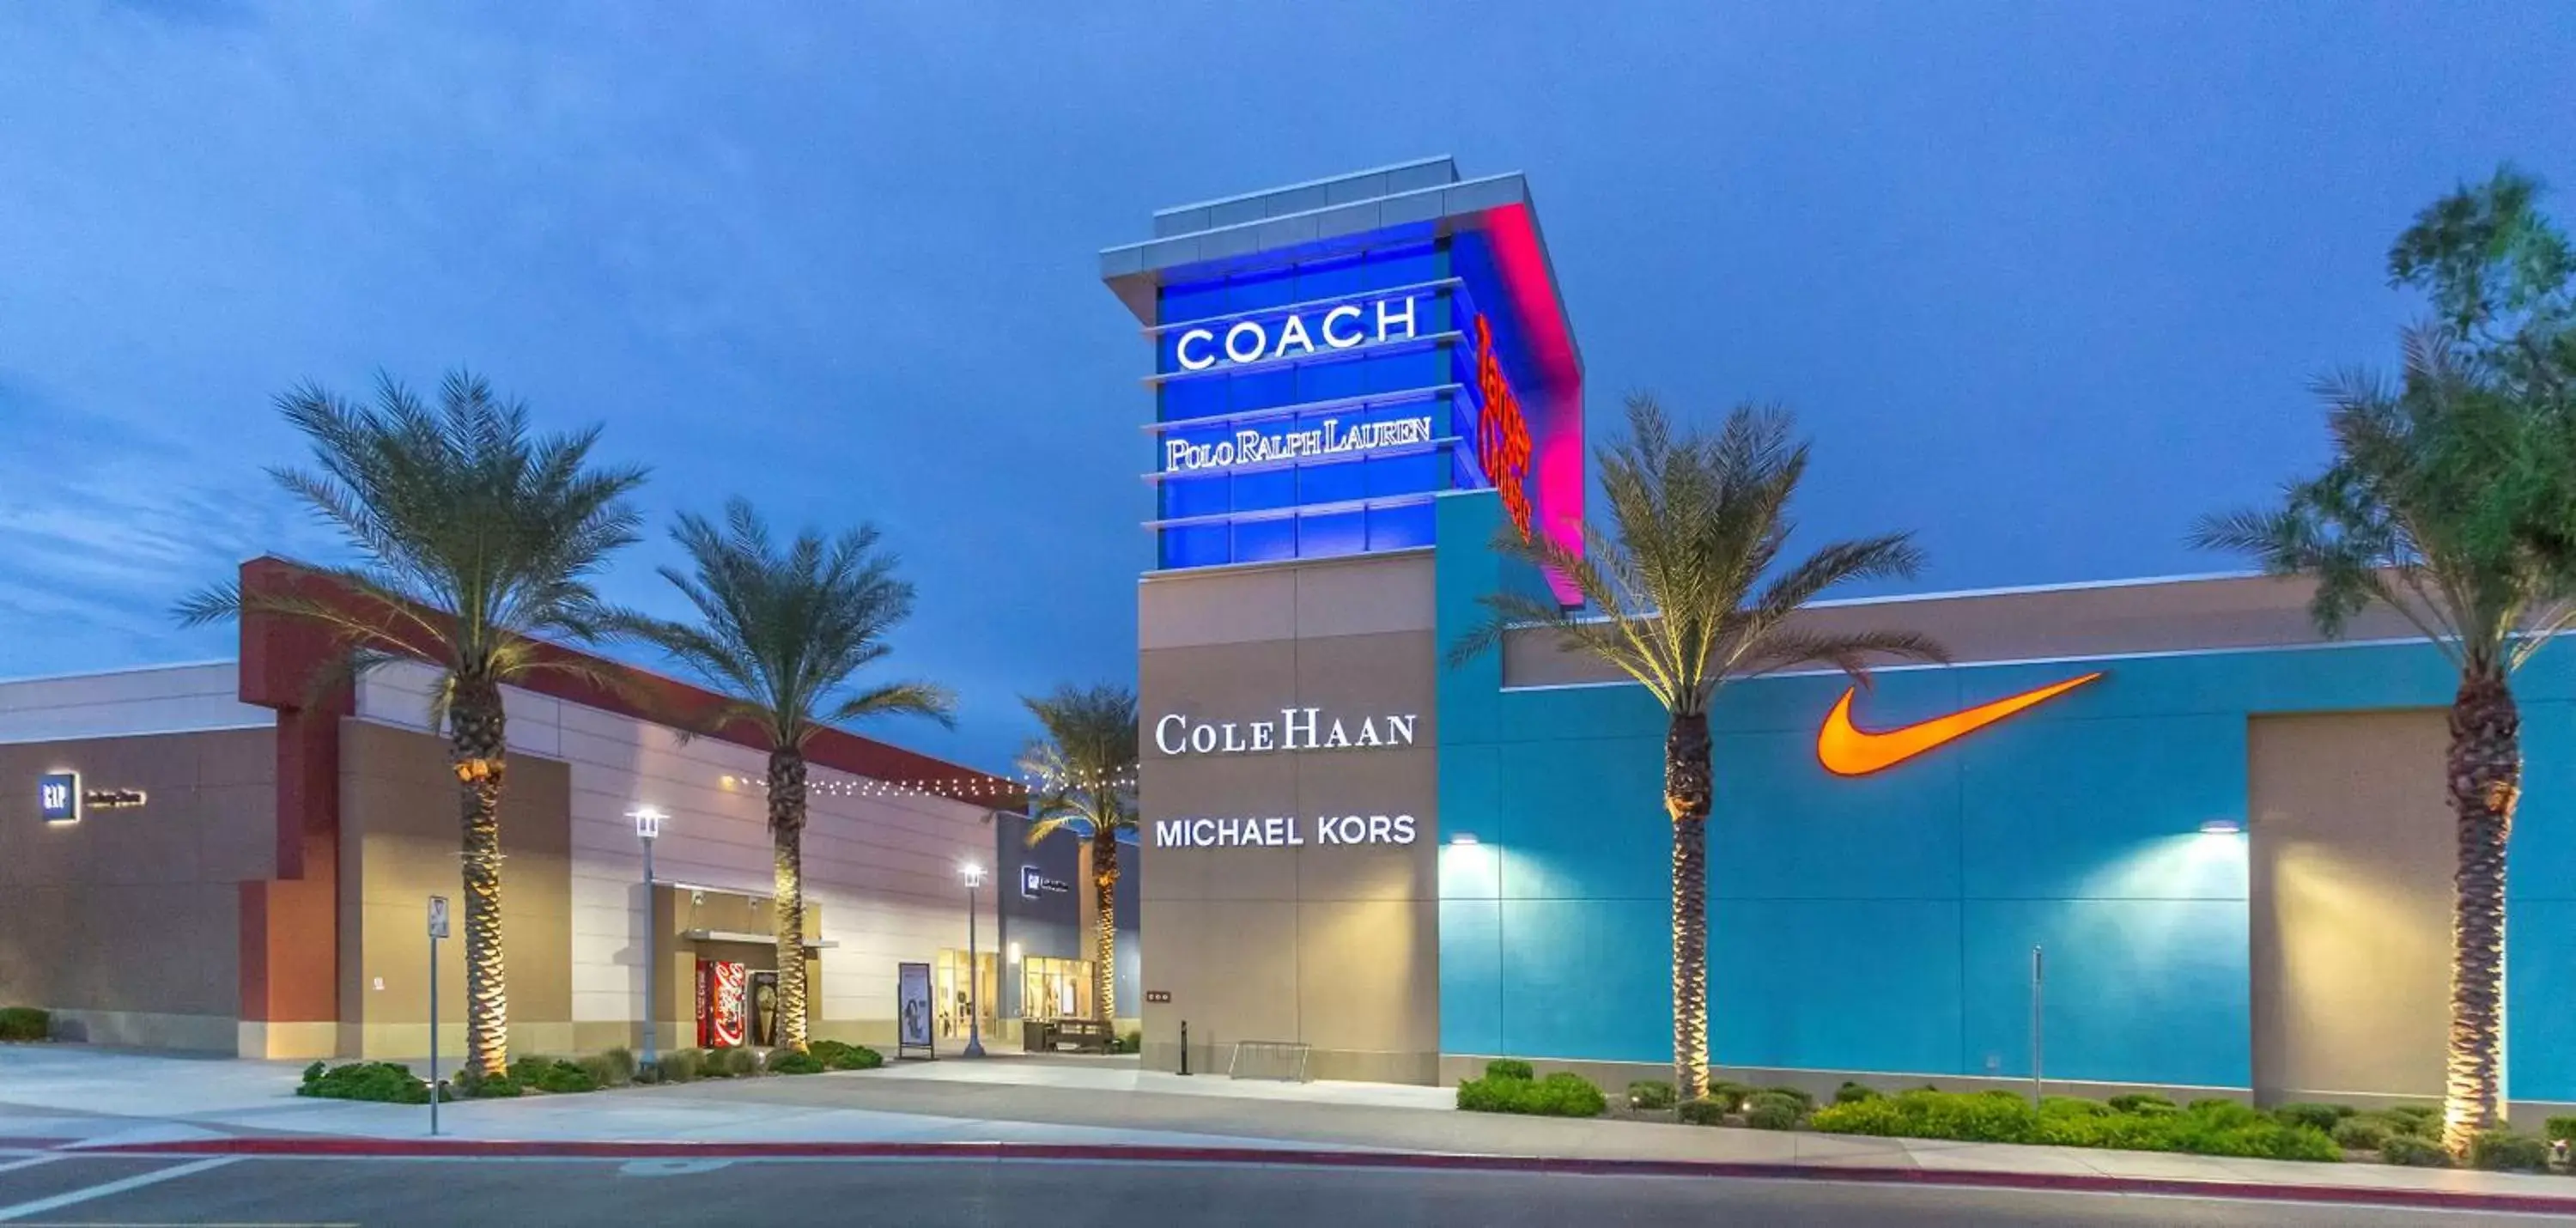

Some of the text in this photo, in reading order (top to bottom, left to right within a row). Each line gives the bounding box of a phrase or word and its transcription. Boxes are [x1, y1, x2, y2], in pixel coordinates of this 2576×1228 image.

[1177, 296, 1415, 370] COACH
[1165, 416, 1431, 472] POLO RALPH LAUREN
[1156, 708, 1416, 755] COLE HAAN
[1156, 815, 1417, 848] MICHAEL KORS
